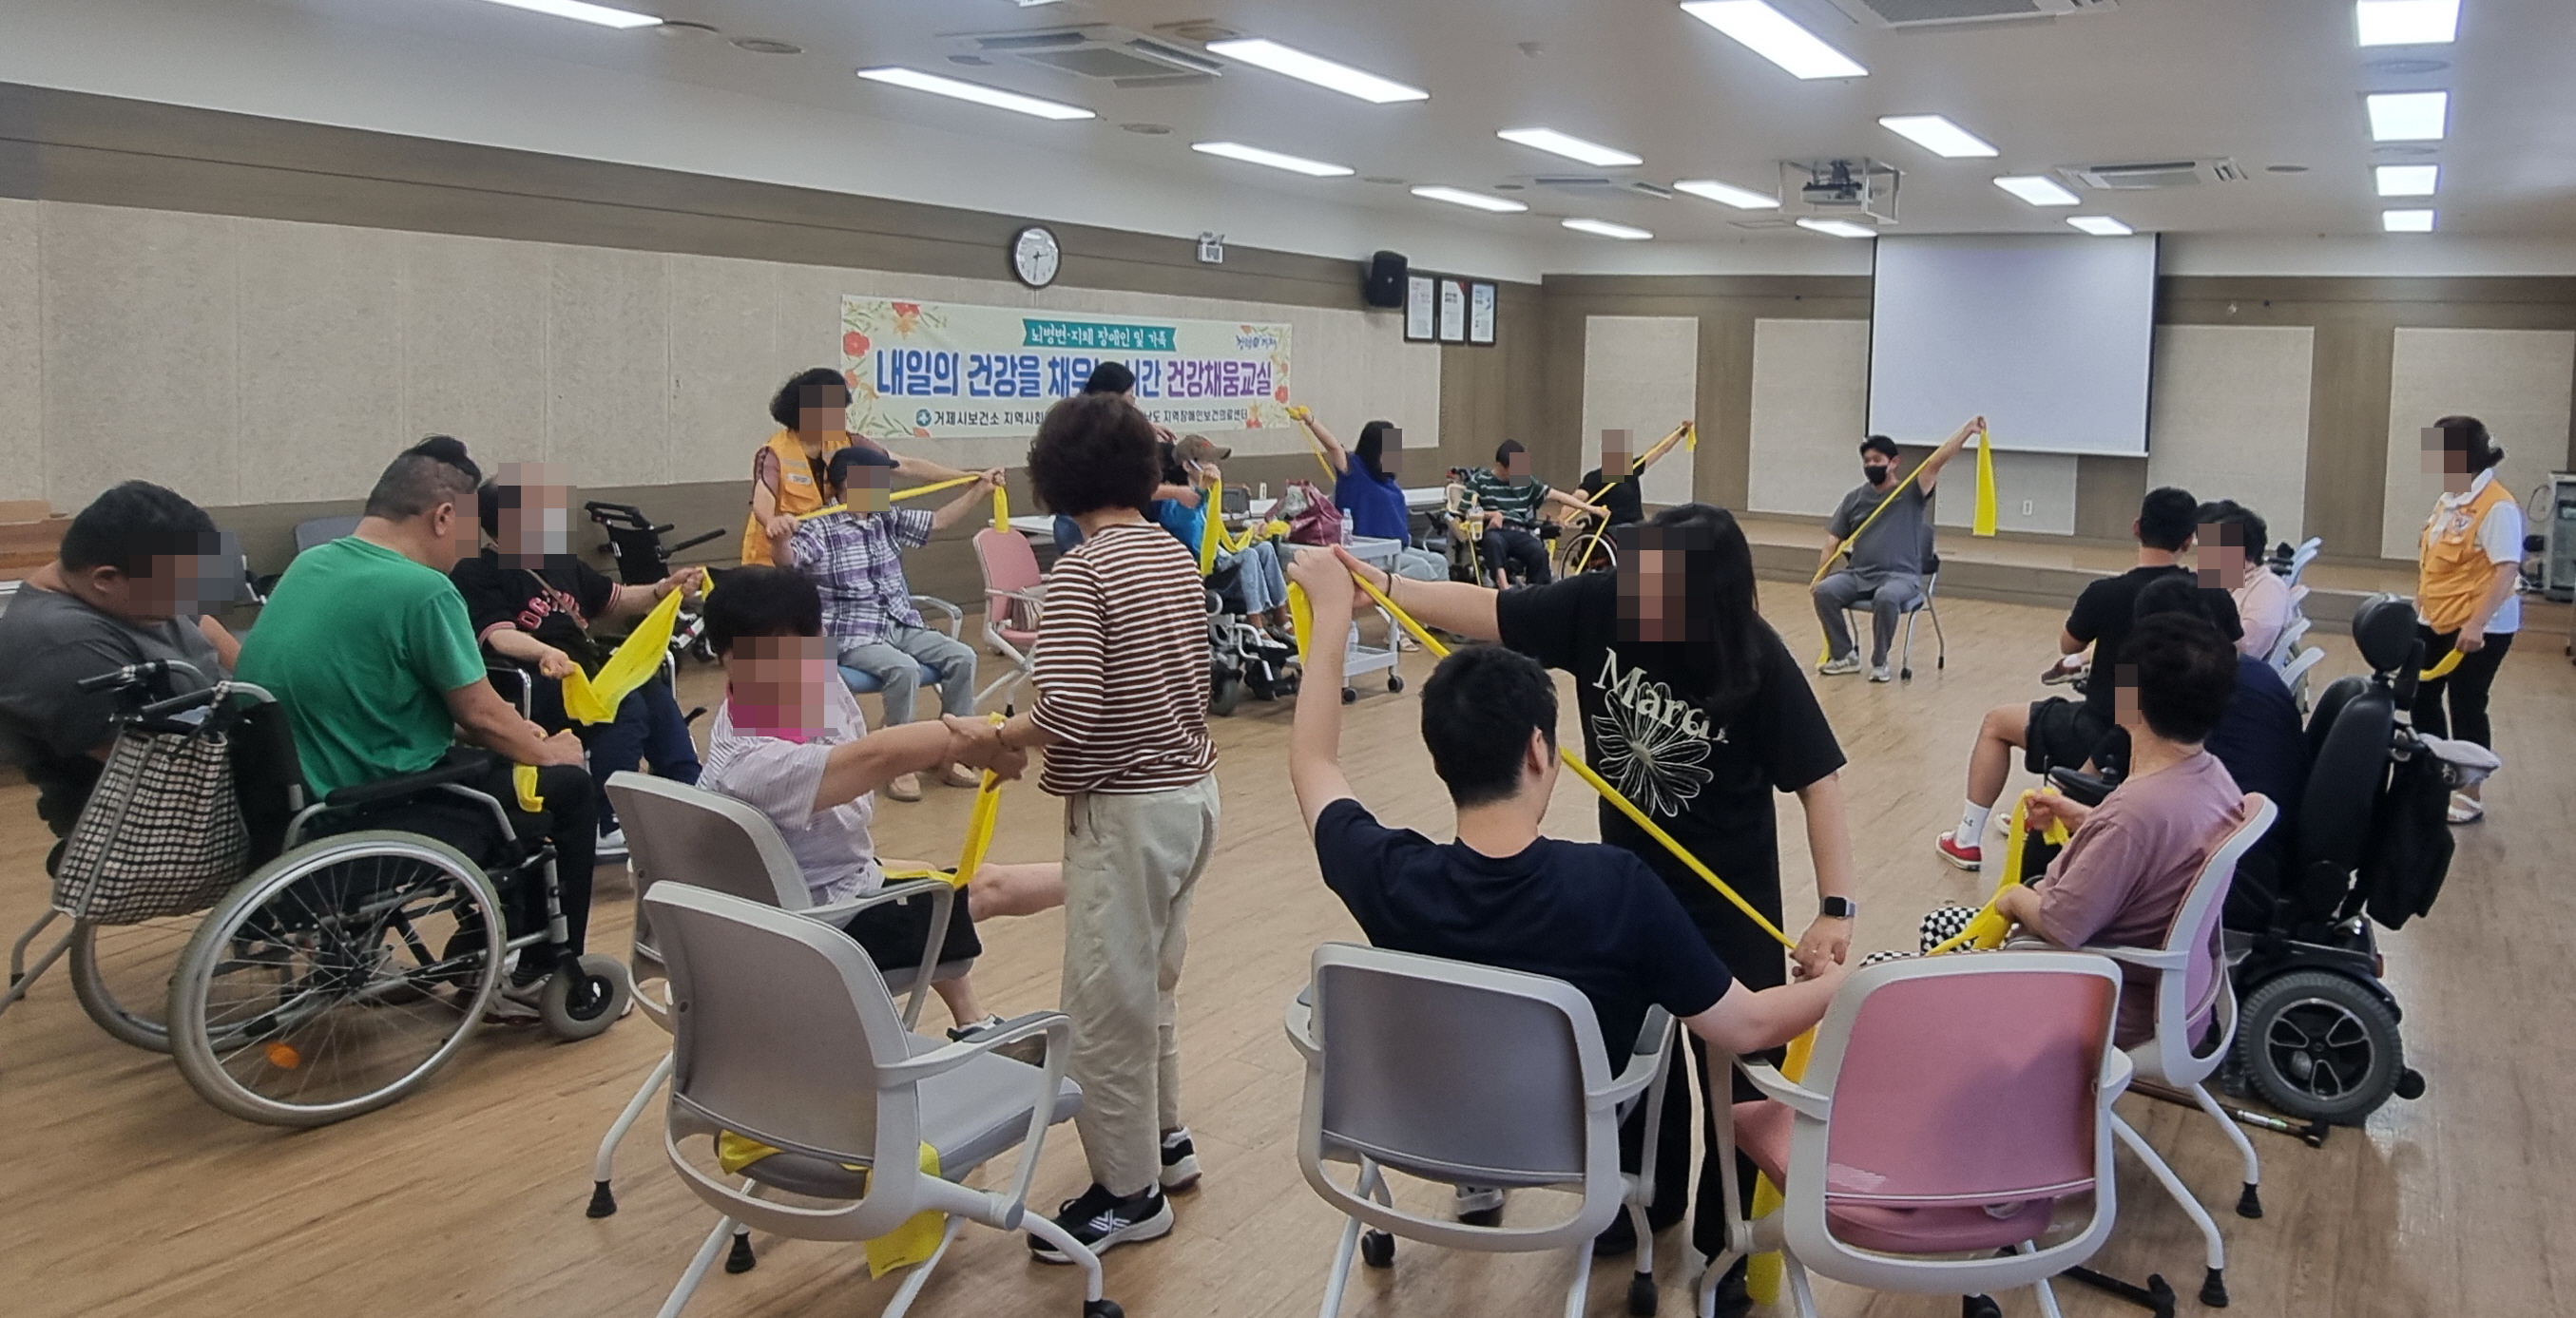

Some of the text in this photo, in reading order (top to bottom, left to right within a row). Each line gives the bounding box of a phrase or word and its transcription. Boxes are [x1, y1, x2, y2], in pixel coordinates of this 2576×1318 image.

[1098, 326, 1129, 348] 장애인
[1134, 329, 1144, 348] 및
[1148, 330, 1167, 348] 가족
[876, 349, 959, 396] 내일의
[968, 353, 1041, 397] 건강을
[1048, 355, 1099, 398] 채우
[1167, 359, 1272, 397] 건강채움교실
[934, 411, 999, 426] 거제시보건소
[1004, 411, 1044, 426] 지역사회
[1163, 409, 1248, 424] 지역장애인보건의료센터
